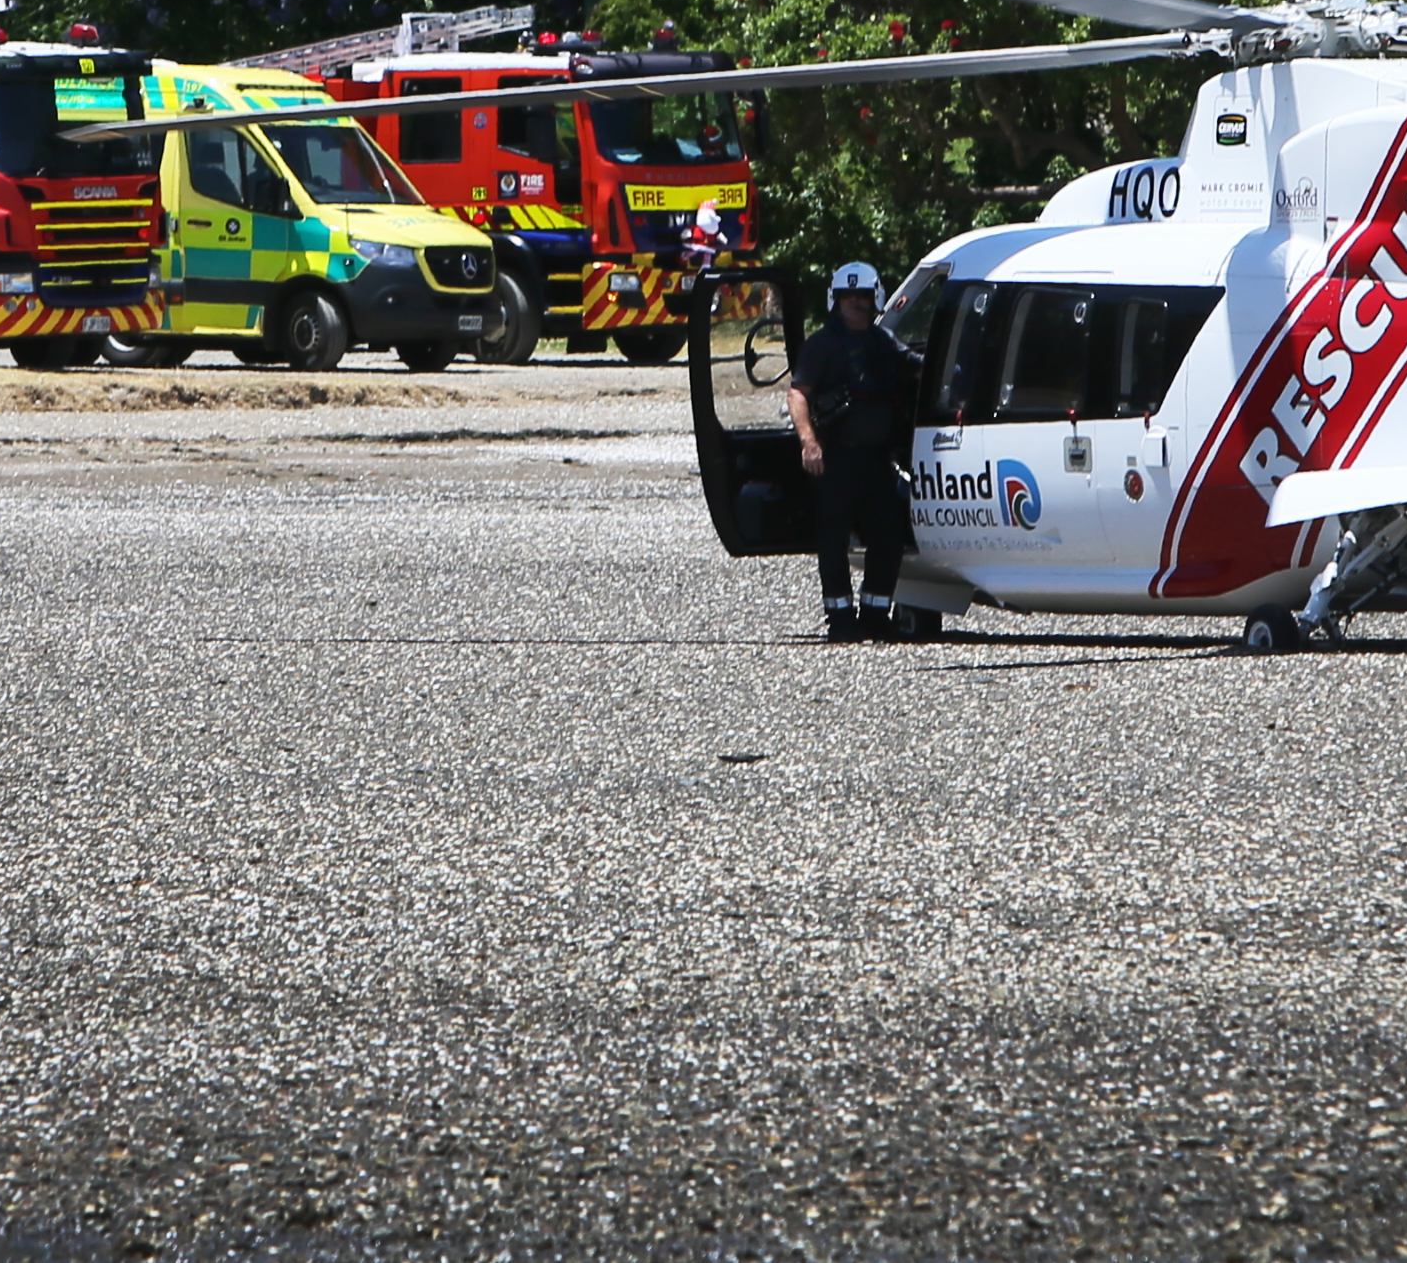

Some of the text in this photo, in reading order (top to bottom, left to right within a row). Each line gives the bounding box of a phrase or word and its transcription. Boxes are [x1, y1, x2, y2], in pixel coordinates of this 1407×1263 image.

[520, 174, 544, 187] FIRE
[1200, 182, 1264, 193] MARK CROMIE
[74, 186, 118, 199] SCANIA
[632, 190, 666, 207] FIRE
[1275, 186, 1318, 208] Oxford
[935, 507, 998, 527] COUNCIL
